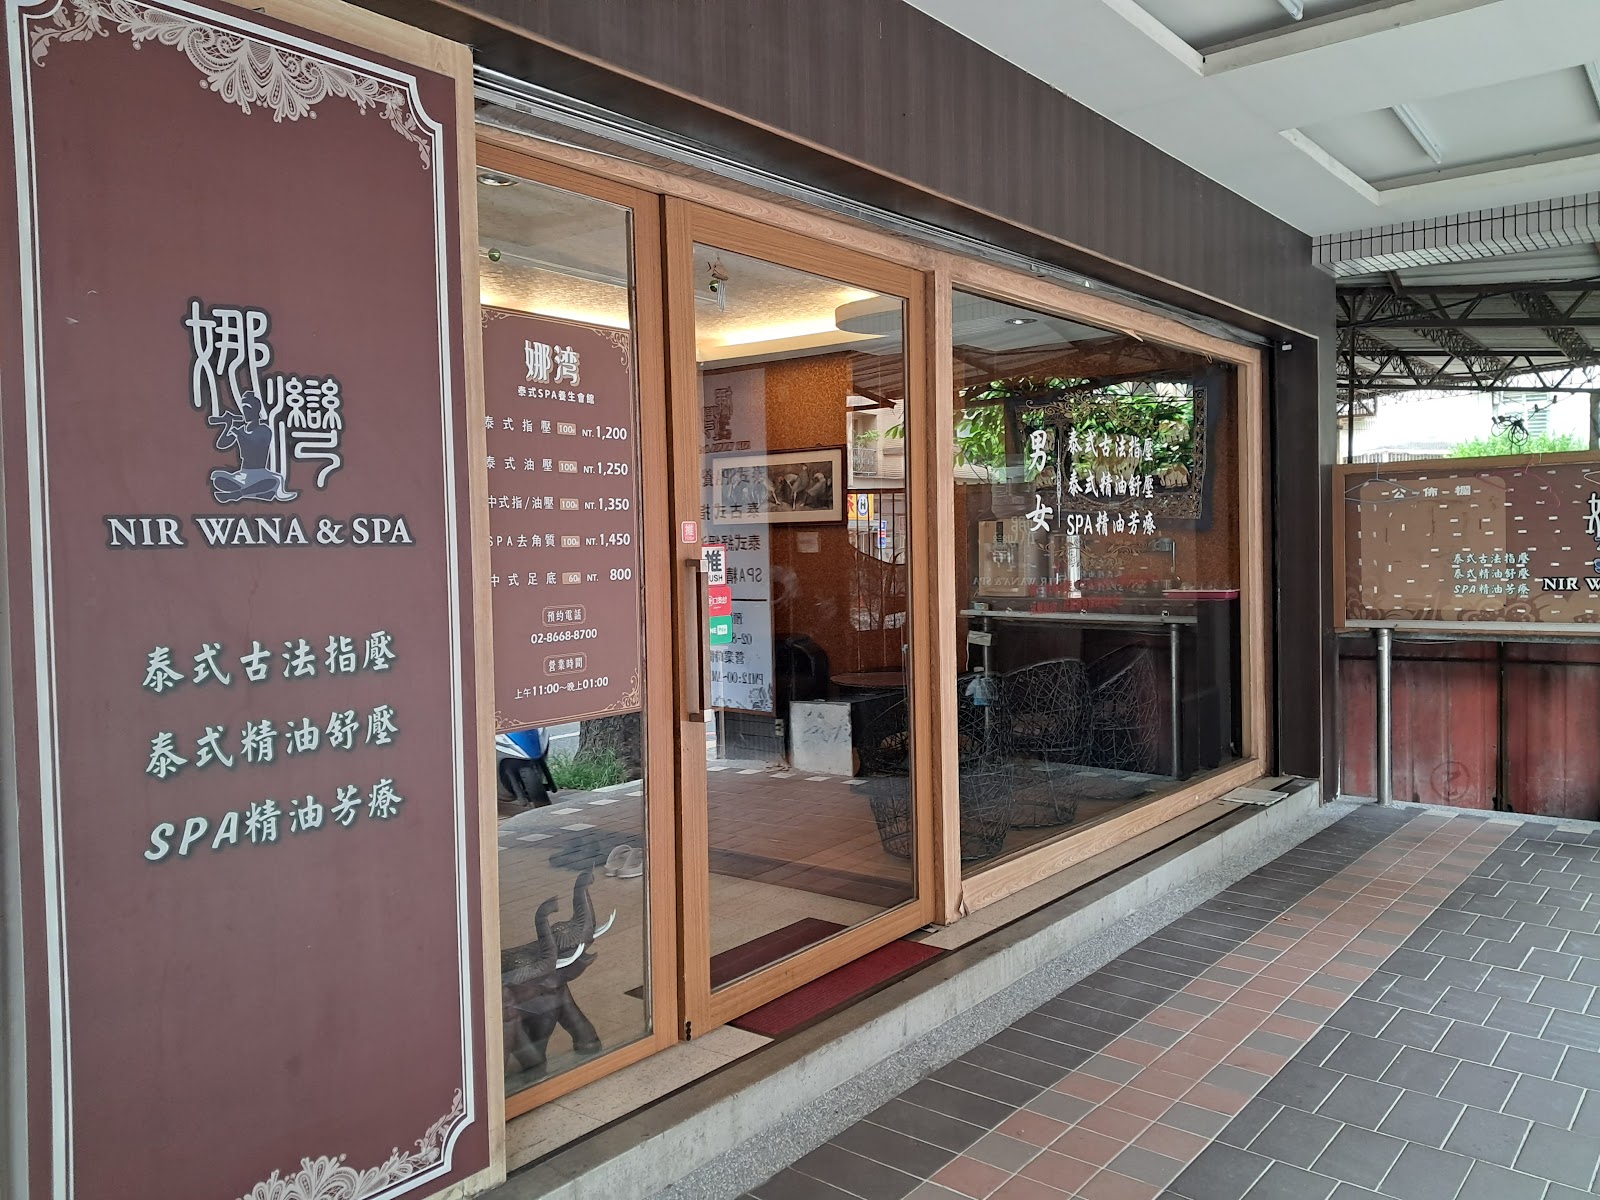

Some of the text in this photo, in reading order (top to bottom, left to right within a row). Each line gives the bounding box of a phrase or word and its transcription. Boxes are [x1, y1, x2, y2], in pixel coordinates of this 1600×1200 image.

[485, 415, 552, 434] 泰式指壓
[596, 425, 628, 440] 1,200
[1068, 428, 1154, 461] 泰式古法指壓
[486, 455, 553, 472] 泰式油壓
[597, 461, 629, 476] 1,250
[1068, 469, 1154, 499] 泰式精油舒壓
[598, 497, 630, 512] 1,350
[108, 517, 412, 546] NIR WANA & SPA
[1066, 510, 1157, 537] SPA精油芳療
[599, 532, 631, 548] 1,450
[705, 550, 722, 573] 推
[1453, 552, 1531, 565] 泰式古法指壓
[491, 571, 557, 587] 中式足底
[609, 567, 632, 581] 800
[708, 574, 723, 583] USH
[1453, 568, 1531, 580] 泰式精油舒壓
[1543, 577, 1579, 591] NIR
[531, 628, 598, 644] 02-8668-8700
[142, 630, 396, 693] 泰式古法指壓
[145, 704, 399, 779] 泰式精油舒壓
[144, 778, 403, 862] SPA精油芳療
